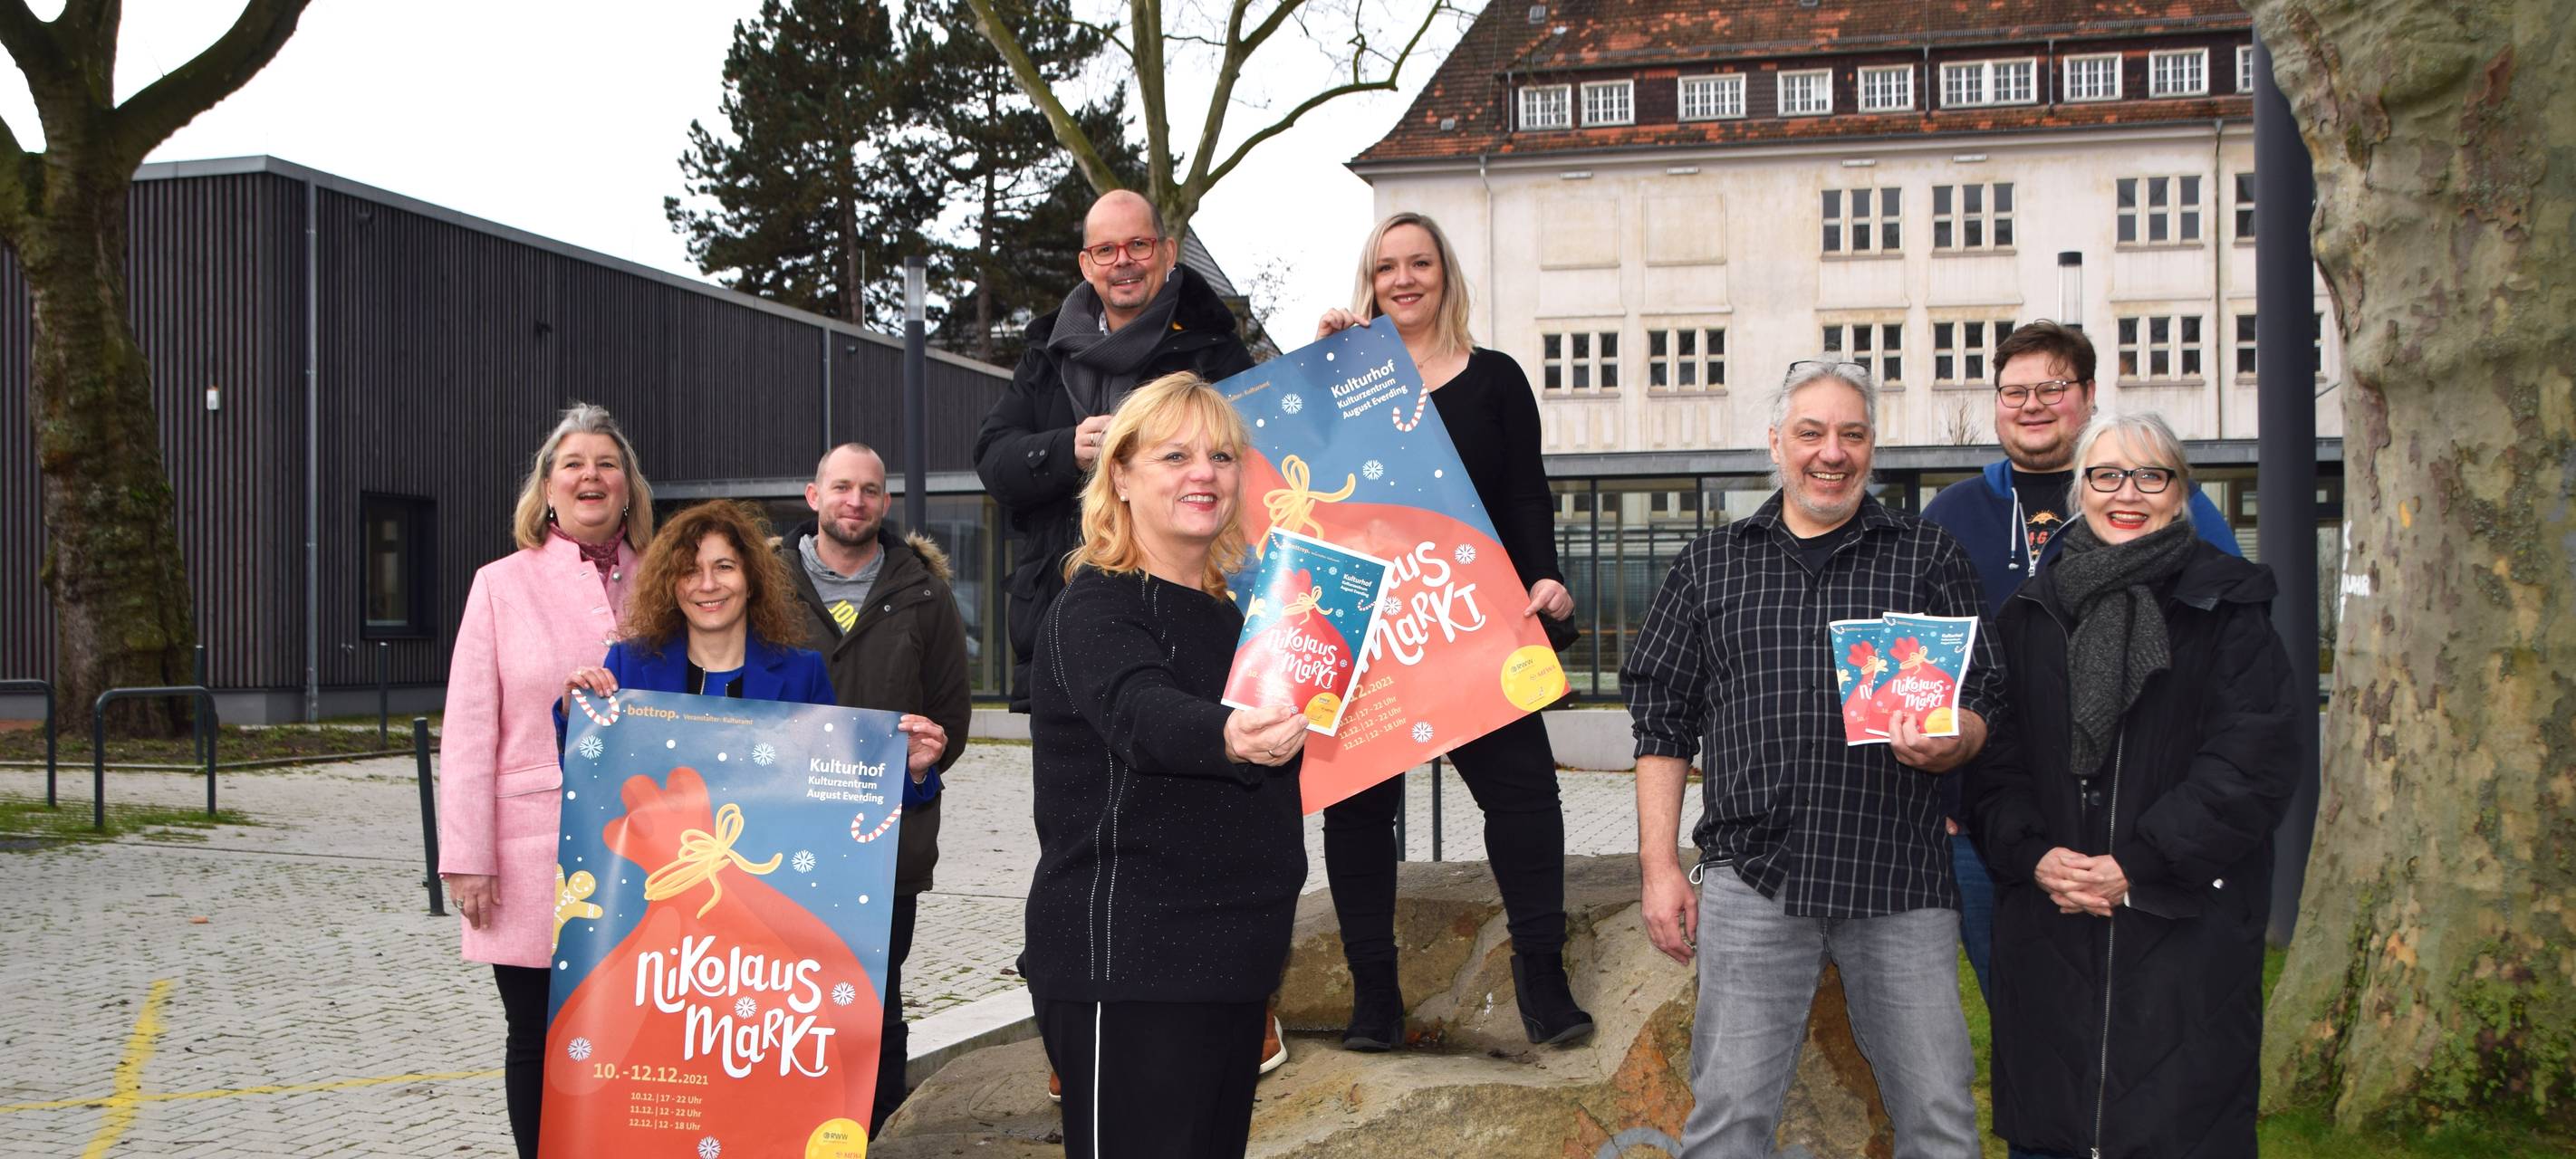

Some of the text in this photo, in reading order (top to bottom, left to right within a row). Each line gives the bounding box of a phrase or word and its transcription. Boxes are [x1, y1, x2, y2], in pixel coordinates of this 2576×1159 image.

[1331, 359, 1396, 398] Kulturhof
[1336, 378, 1396, 409] Kulturzentrum
[1342, 385, 1408, 420] August Everding
[1343, 573, 1373, 588] Kulturhof
[1383, 695, 1398, 705] Uhr
[627, 704, 679, 722] bottrop.
[1388, 706, 1402, 717] Uhr
[1392, 716, 1407, 728] Uhr
[810, 758, 886, 777] Kulturhof
[808, 776, 878, 790] Kulturzentrum
[806, 789, 885, 805] August Everding
[630, 1092, 655, 1101] 10.12.
[677, 1096, 687, 1104] 22
[688, 1096, 703, 1105] Uhr
[630, 1106, 654, 1114] 11.12.
[659, 1107, 669, 1116] 12
[676, 1108, 686, 1116] 22
[687, 1109, 702, 1117] Uhr
[629, 1118, 653, 1127] 12.12.
[675, 1122, 685, 1130] 18
[686, 1123, 701, 1131] Uhr
